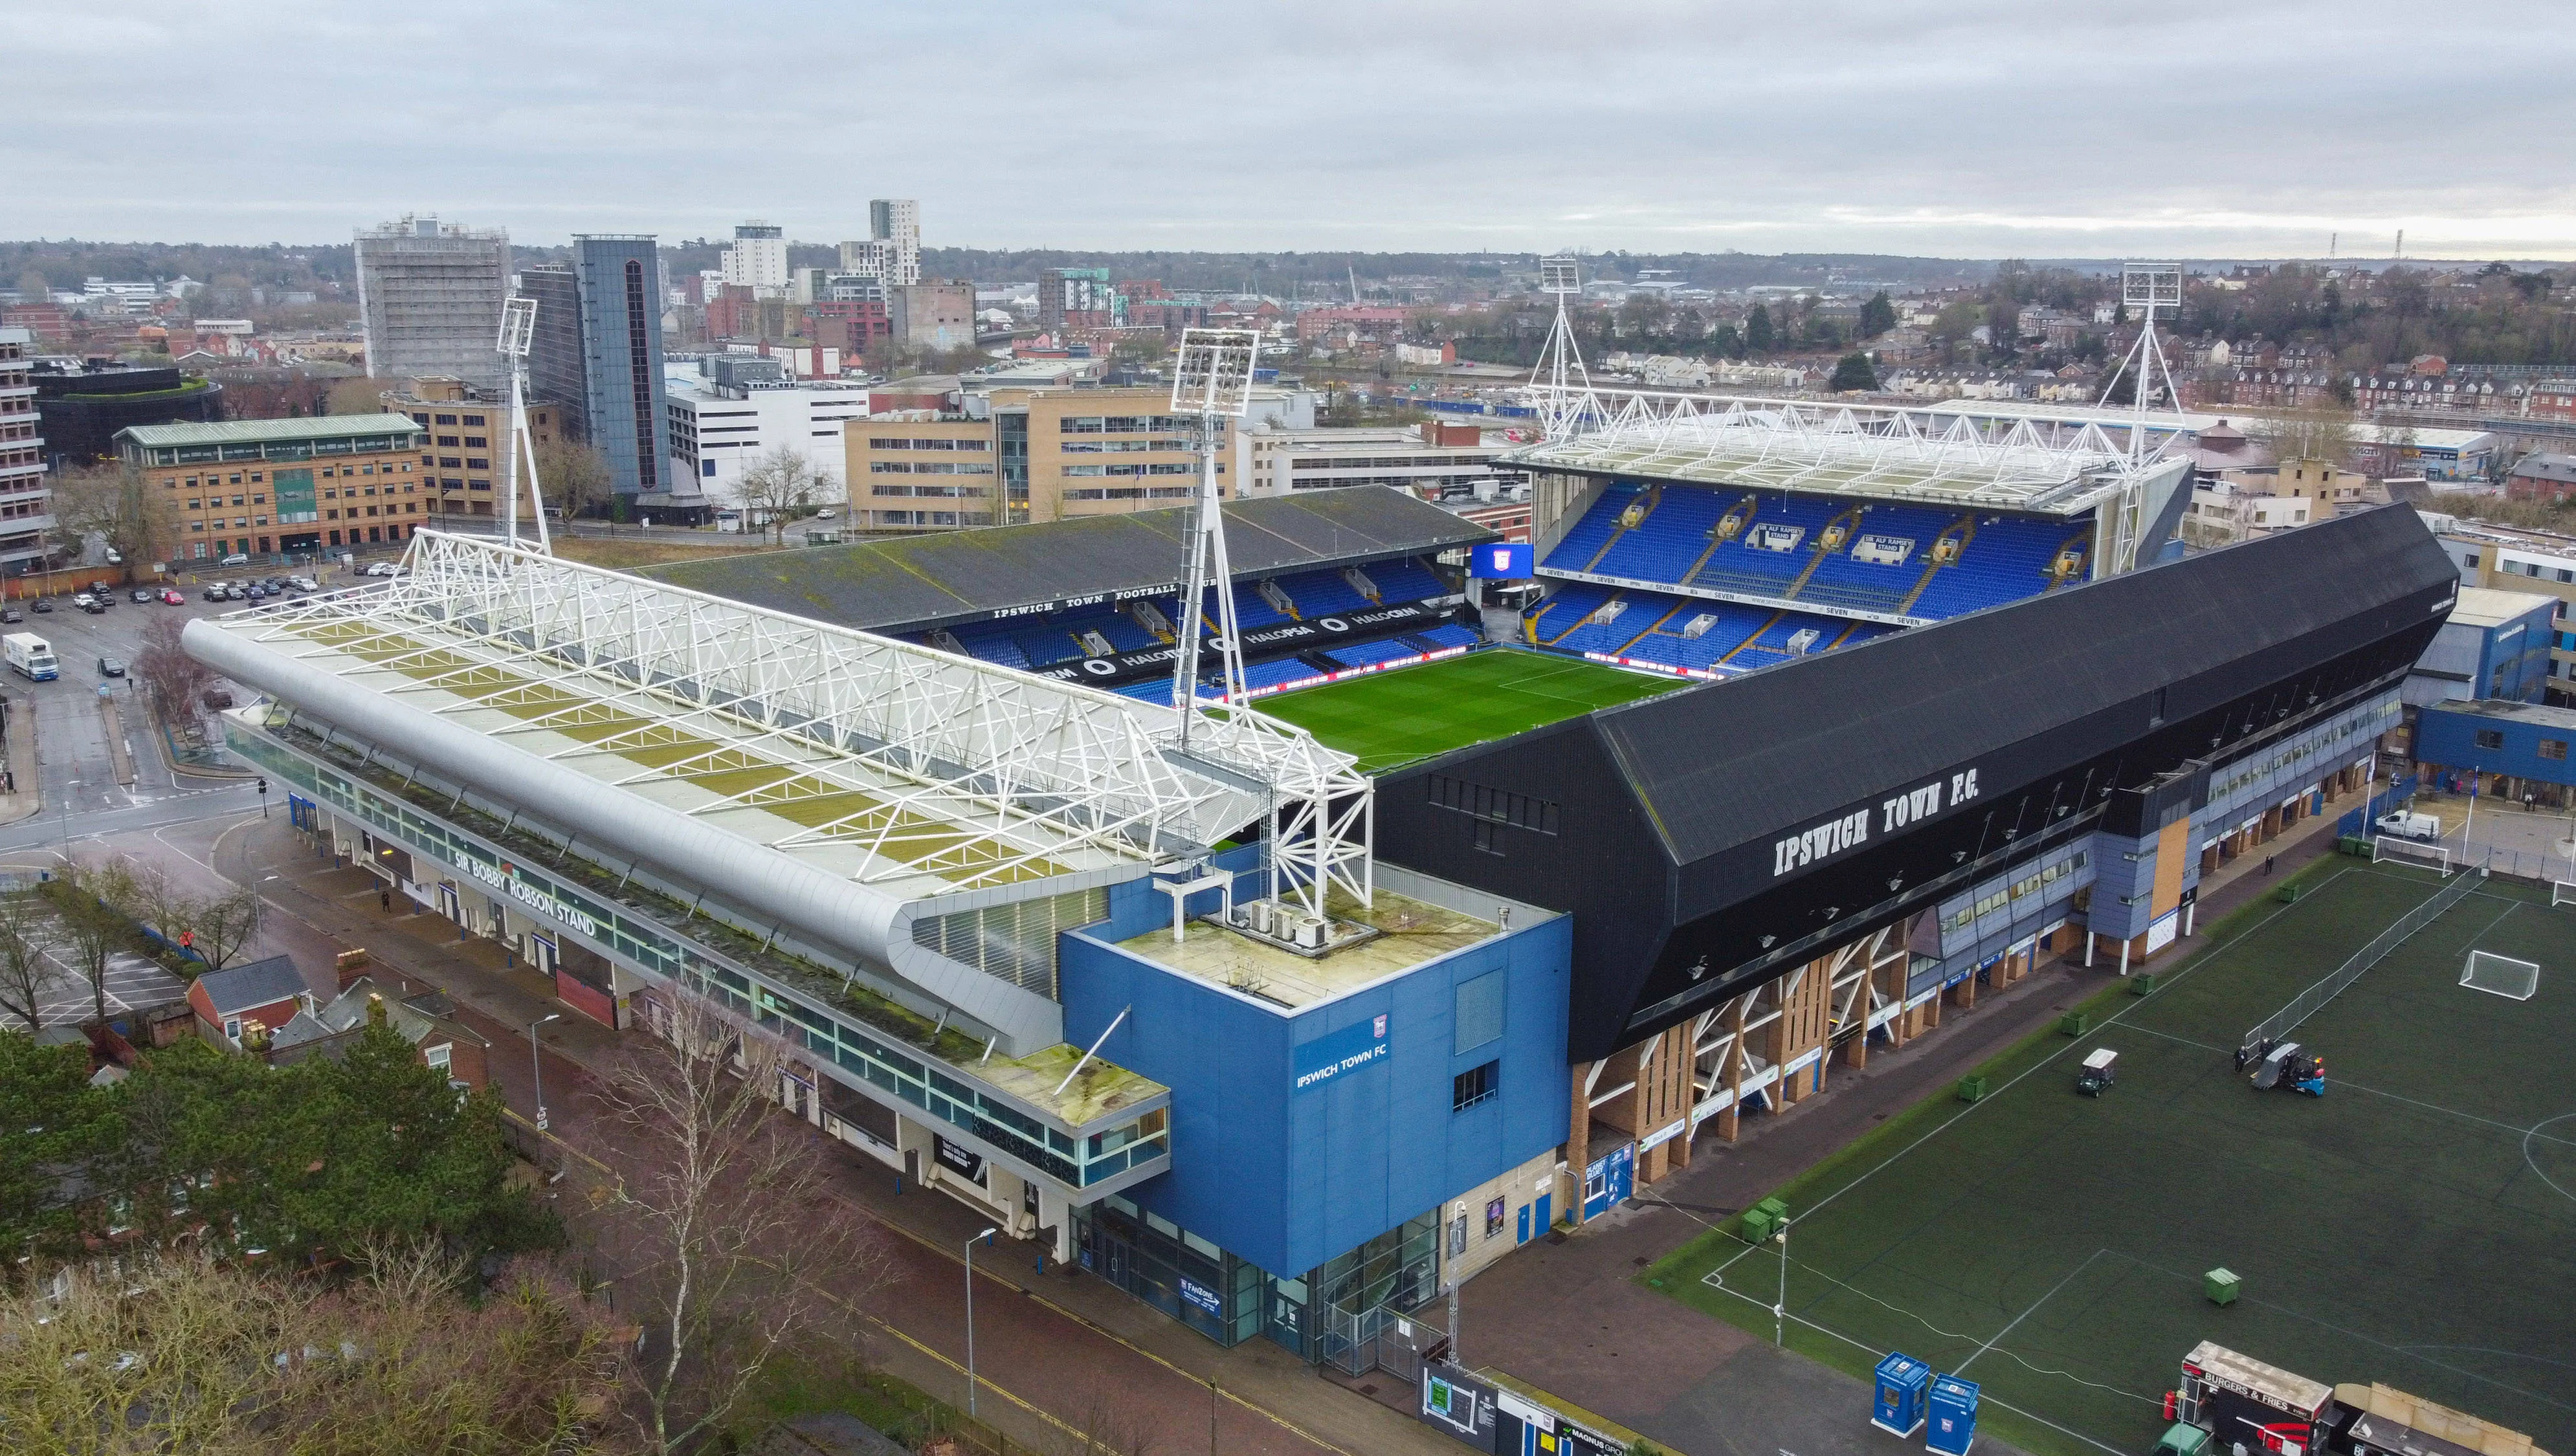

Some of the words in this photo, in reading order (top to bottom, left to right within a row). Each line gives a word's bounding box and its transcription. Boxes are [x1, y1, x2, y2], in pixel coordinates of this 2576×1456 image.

[1546, 569, 1564, 577] SEVEN
[1597, 576, 1616, 584] SEVEN
[994, 602, 1054, 619] IPSWICH
[1066, 595, 1104, 608] TOWN
[1116, 584, 1177, 601] FOOTBALL
[1714, 591, 1735, 601] SEVEN
[1826, 607, 1848, 616] SEVEN
[1896, 617, 1920, 626] SEVEN
[1245, 625, 1315, 645] HALOPSA
[1351, 606, 1421, 624] HALOCRM
[1774, 809, 1869, 876] IPSWICH
[1883, 782, 1941, 832] TOWN
[1950, 768, 1978, 806] F.C.
[455, 852, 469, 874] SIR
[472, 860, 506, 891] BOBBY
[509, 879, 554, 917] ROBSON
[557, 903, 595, 937] STAND
[1297, 1063, 1338, 1088] IPSWICH
[1340, 1050, 1372, 1070] TOWN
[1374, 1044, 1386, 1057] FC
[2205, 1373, 2248, 1395] BURGERS
[2250, 1390, 2259, 1400] &
[2263, 1395, 2288, 1411] FRIES
[1572, 1429, 1604, 1449] MAGNUS
